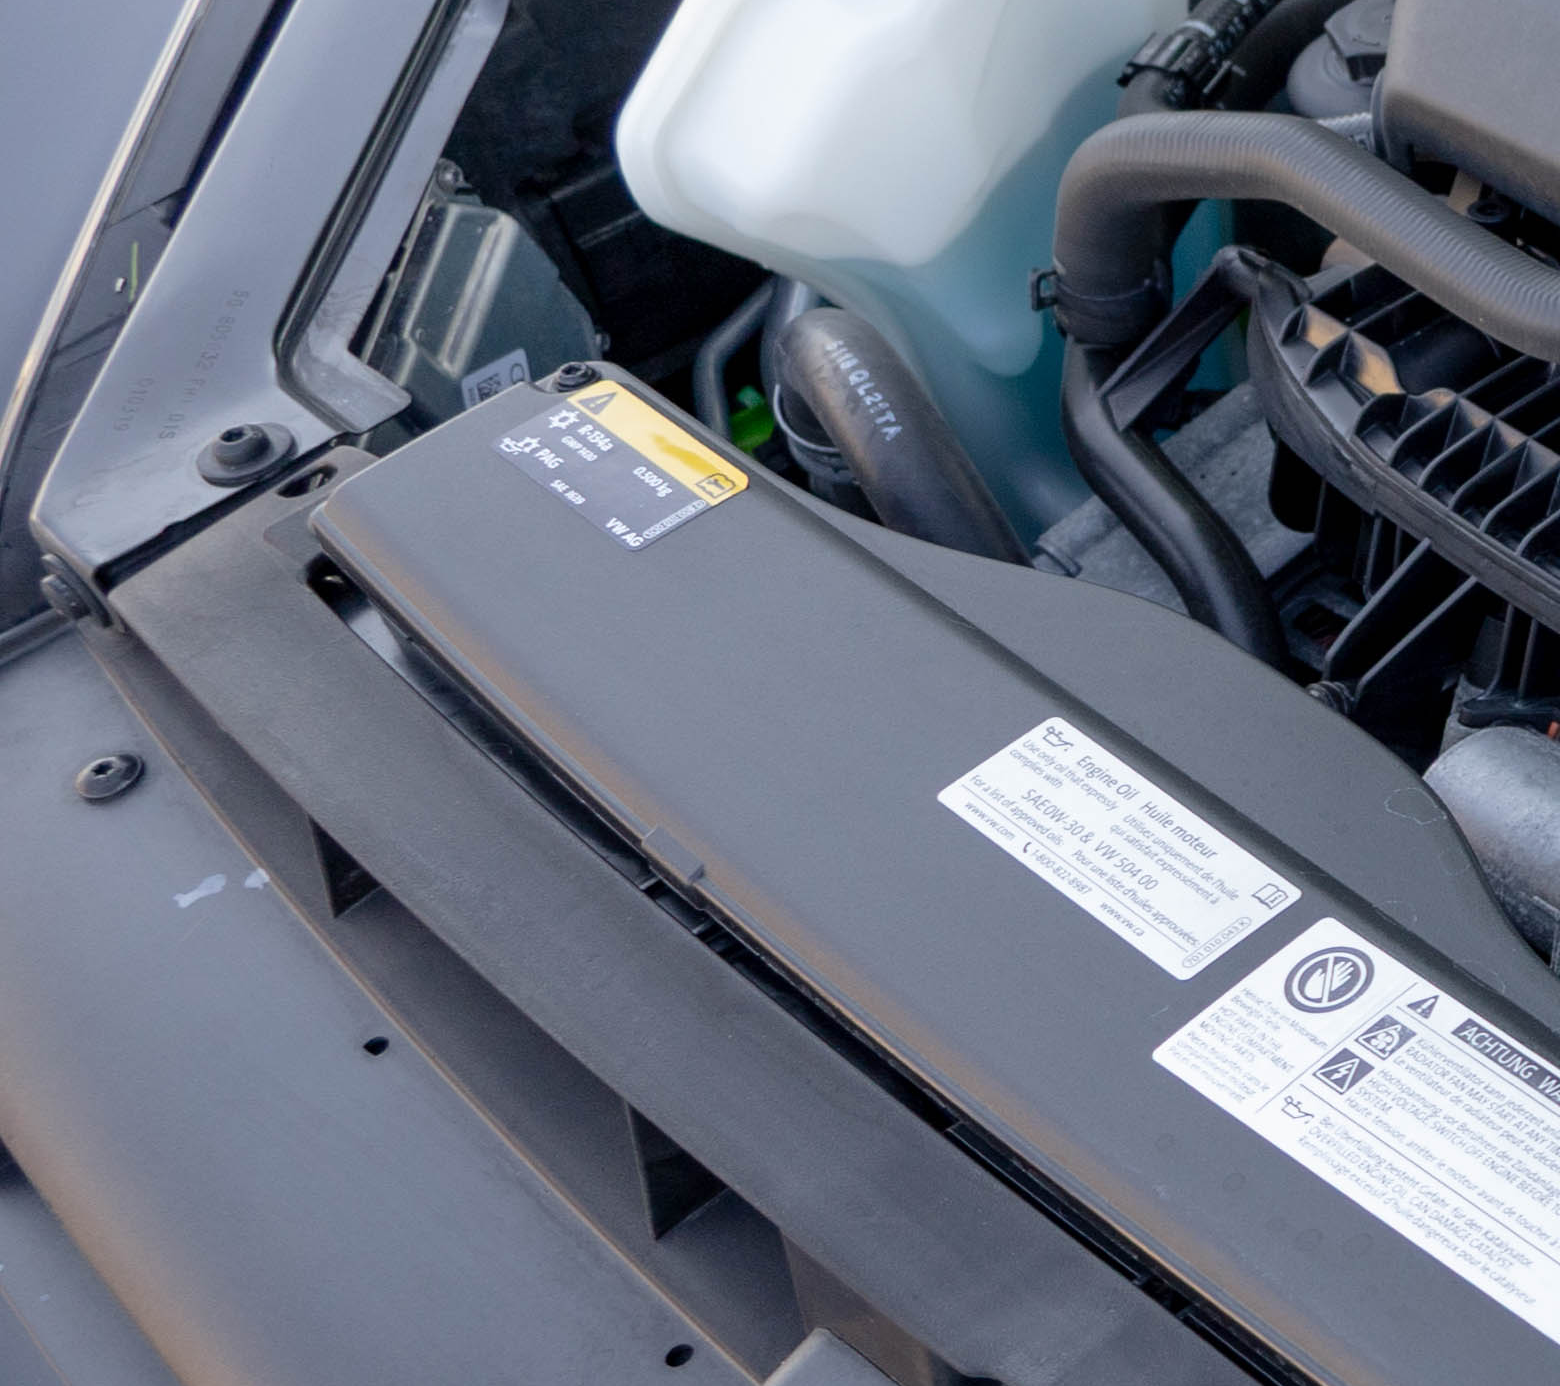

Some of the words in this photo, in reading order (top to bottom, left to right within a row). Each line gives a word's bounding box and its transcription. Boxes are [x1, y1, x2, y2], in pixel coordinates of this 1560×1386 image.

[533, 447, 564, 469] PAG
[653, 481, 674, 498] kg
[604, 516, 630, 536] VW
[620, 531, 645, 547] AG
[1074, 754, 1119, 789] Engine
[1114, 782, 1140, 801] Oil
[1138, 800, 1175, 829] Huile
[1169, 824, 1218, 859] moteur
[1459, 1025, 1538, 1079] ACHTUNG
